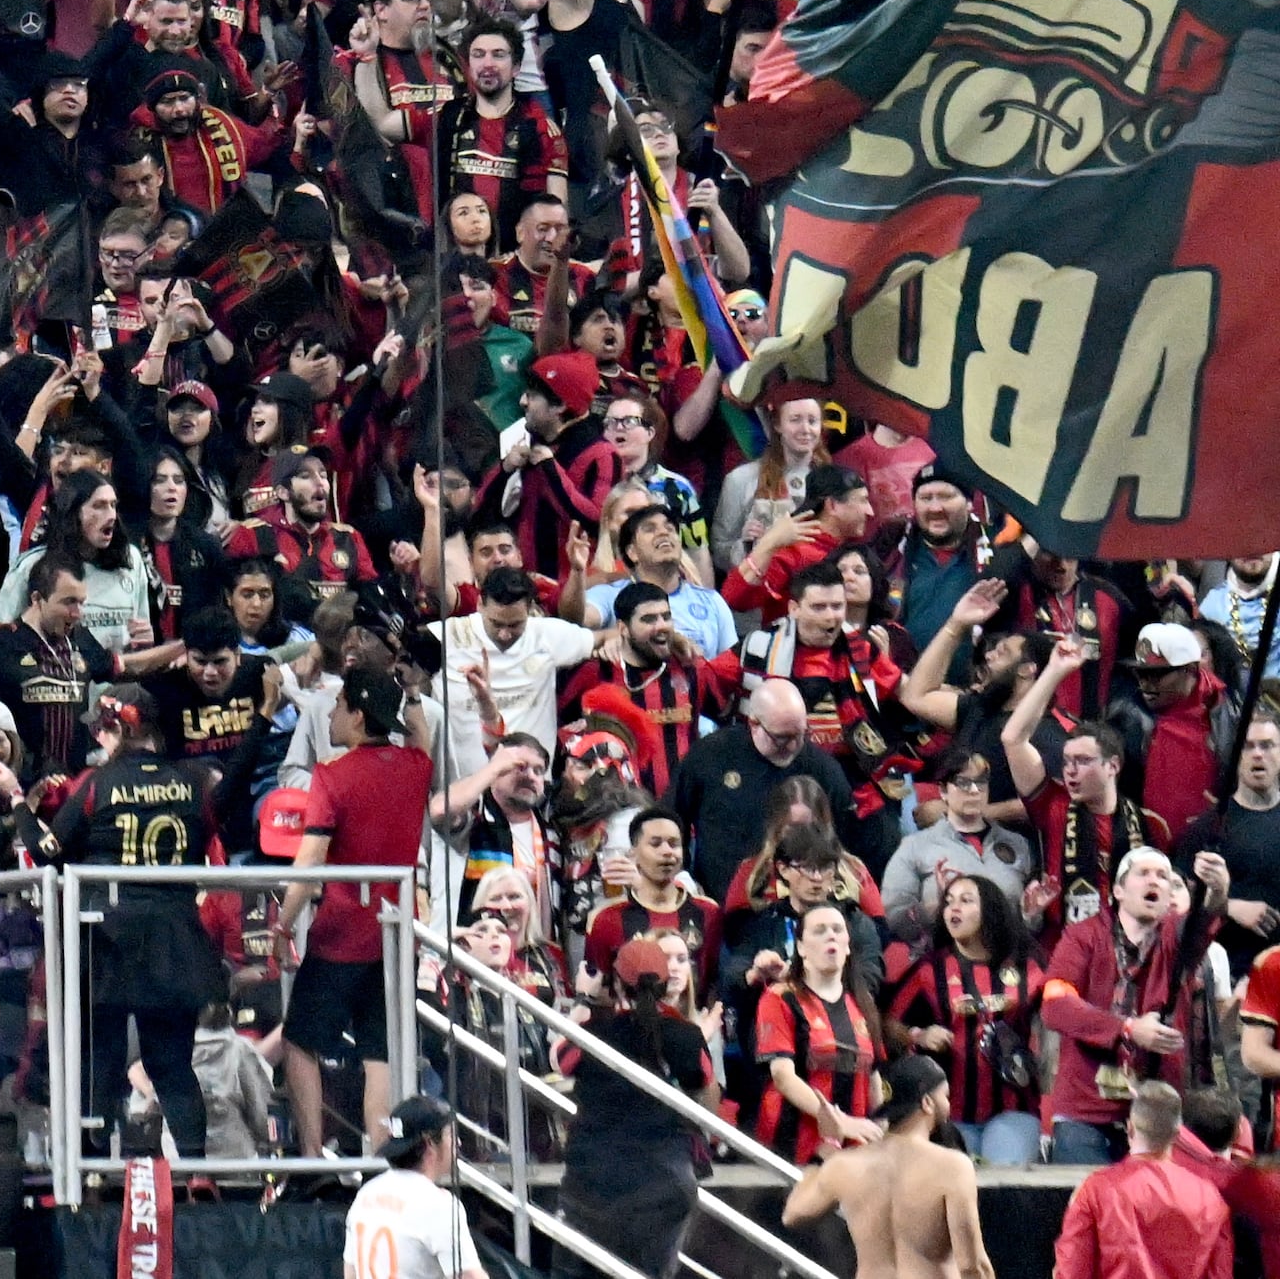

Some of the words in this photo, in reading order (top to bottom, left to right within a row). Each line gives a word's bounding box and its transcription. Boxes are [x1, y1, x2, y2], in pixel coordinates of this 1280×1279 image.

[110, 780, 193, 806] ALMIRÓN
[115, 812, 189, 866] 10
[130, 1156, 157, 1234] THESE
